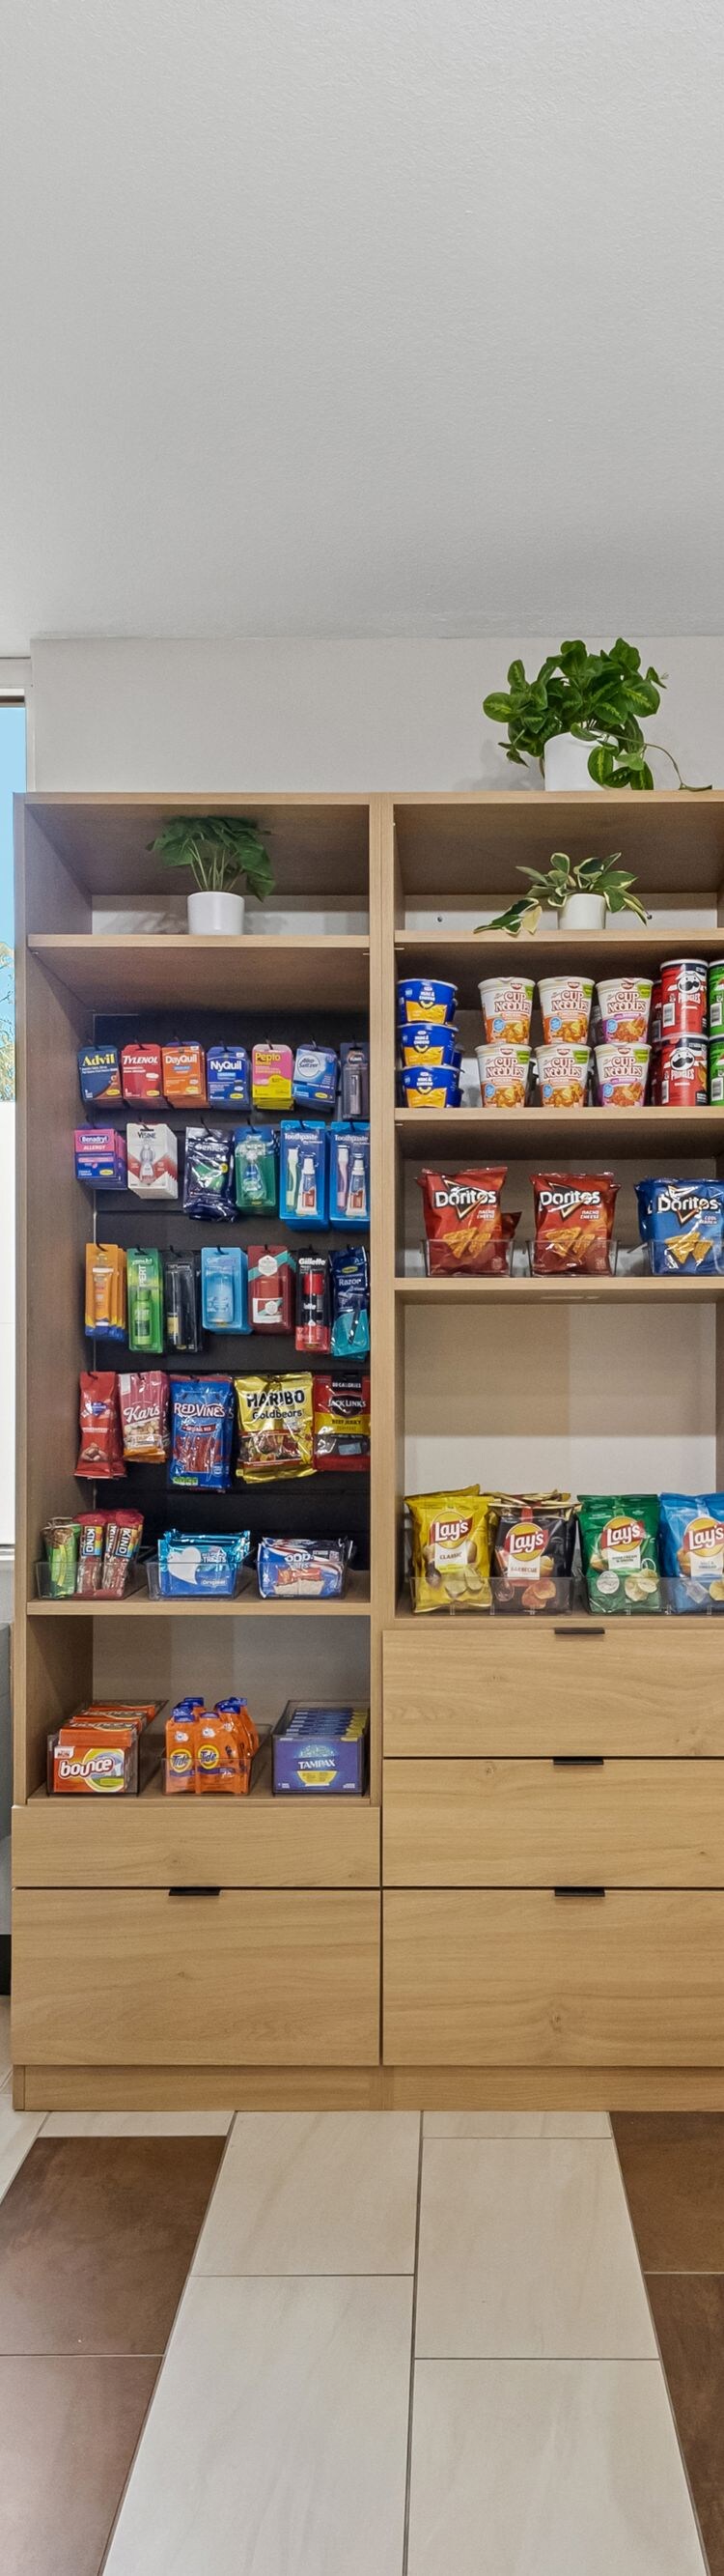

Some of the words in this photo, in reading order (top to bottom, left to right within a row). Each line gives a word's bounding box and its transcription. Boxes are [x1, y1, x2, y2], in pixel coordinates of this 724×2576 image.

[503, 991, 526, 1002] CUP
[560, 990, 583, 1002] CUP
[615, 992, 640, 1002] CUP
[551, 1000, 589, 1012] NOODLES
[607, 1001, 646, 1013] NOODLES
[82, 1053, 116, 1066] Advil
[123, 1055, 158, 1064] TYLENOL
[165, 1055, 197, 1065] DayQuil
[255, 1052, 281, 1062] Pepto
[494, 1057, 518, 1067] CUP
[551, 1058, 575, 1067] CUP
[611, 1058, 636, 1066] CUP
[209, 1061, 242, 1072] NyQuil
[486, 1065, 524, 1078] NOODLES
[543, 1065, 581, 1078] NOODLES
[603, 1065, 643, 1078] NOODLES
[80, 1135, 107, 1144] Benadryl
[435, 1187, 497, 1207] Doritos
[540, 1190, 600, 1206] Doritos
[657, 1196, 719, 1212] Doritos
[246, 1390, 305, 1407] HARIBO
[123, 1402, 160, 1424] Kar's
[174, 1402, 196, 1416] RED
[196, 1402, 226, 1418] VINES
[253, 1410, 303, 1420] Goldbears
[434, 1519, 469, 1542] Lay's
[606, 1523, 641, 1546] Lay's
[85, 1527, 96, 1552] KIND
[118, 1527, 132, 1554] KIND
[510, 1531, 544, 1553] Lay's
[688, 1526, 724, 1550] Lay's
[200, 1749, 217, 1764] Tide
[59, 1758, 114, 1778] bounce
[297, 1759, 336, 1769] TAMPAX
